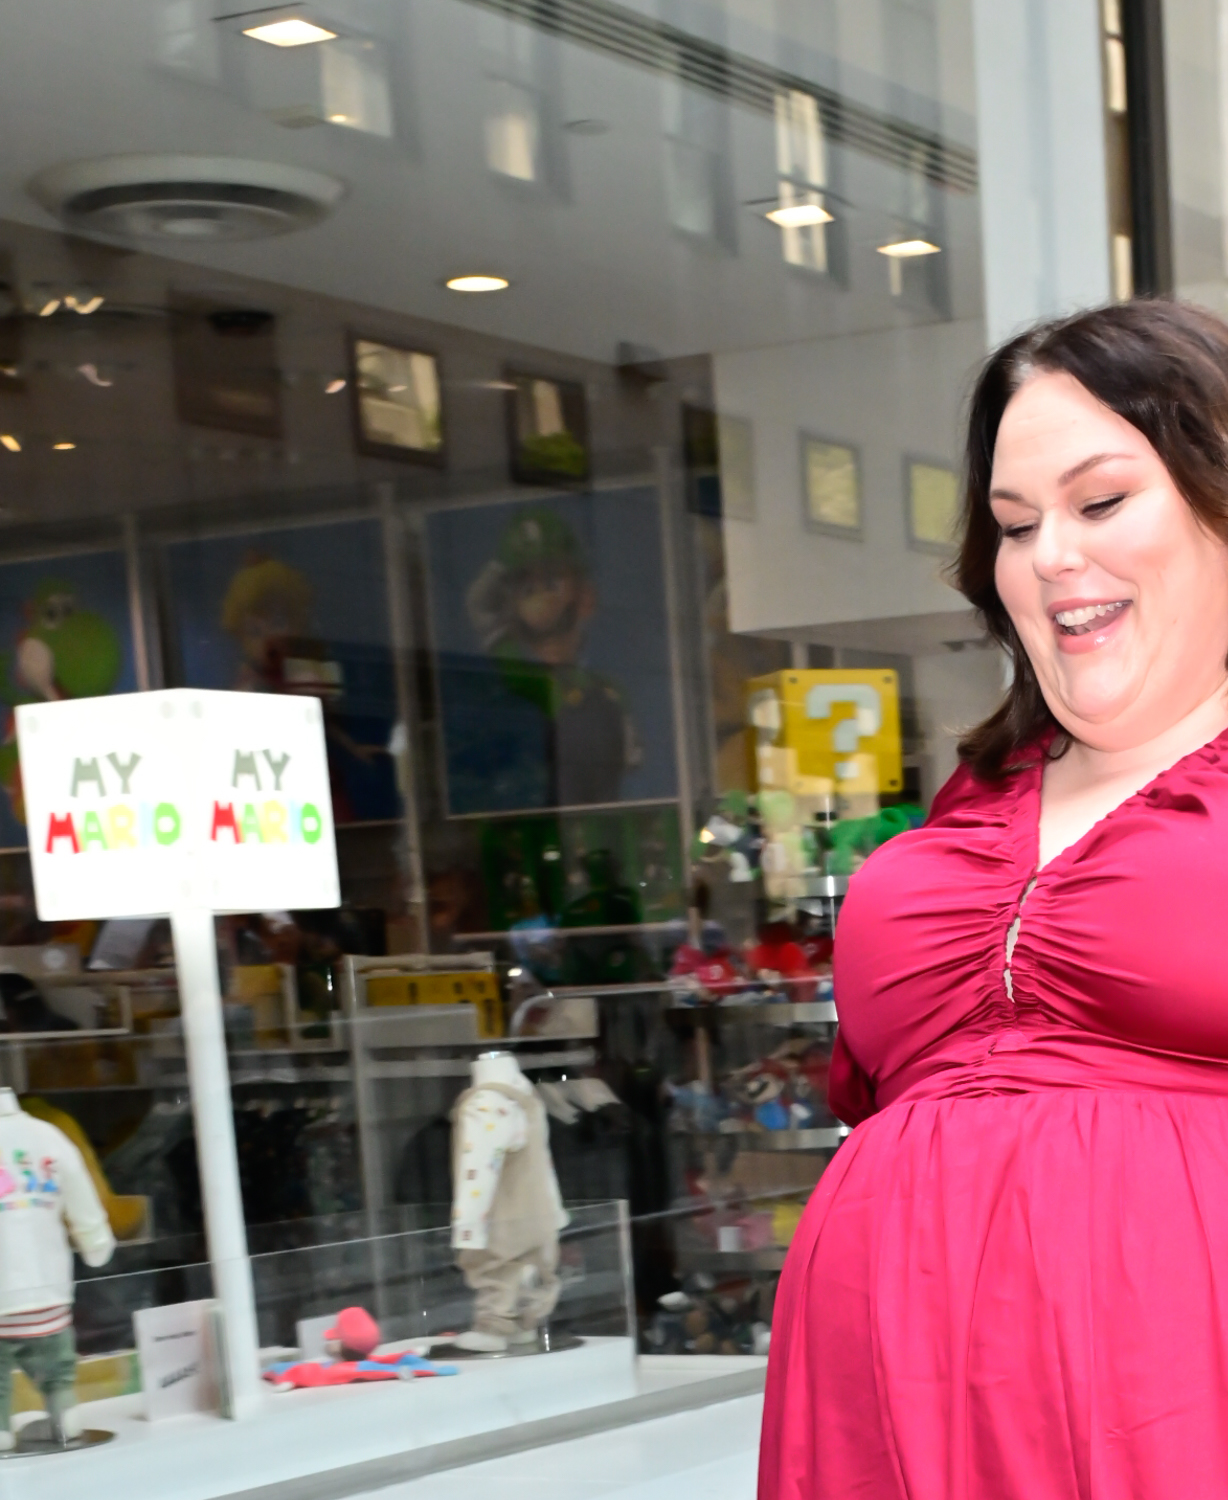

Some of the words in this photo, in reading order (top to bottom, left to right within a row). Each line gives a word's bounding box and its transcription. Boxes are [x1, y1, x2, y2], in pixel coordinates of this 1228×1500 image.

[70, 752, 143, 798] MY
[231, 748, 292, 792] MY
[45, 802, 182, 854] MARIO
[209, 799, 323, 845] MARIO
